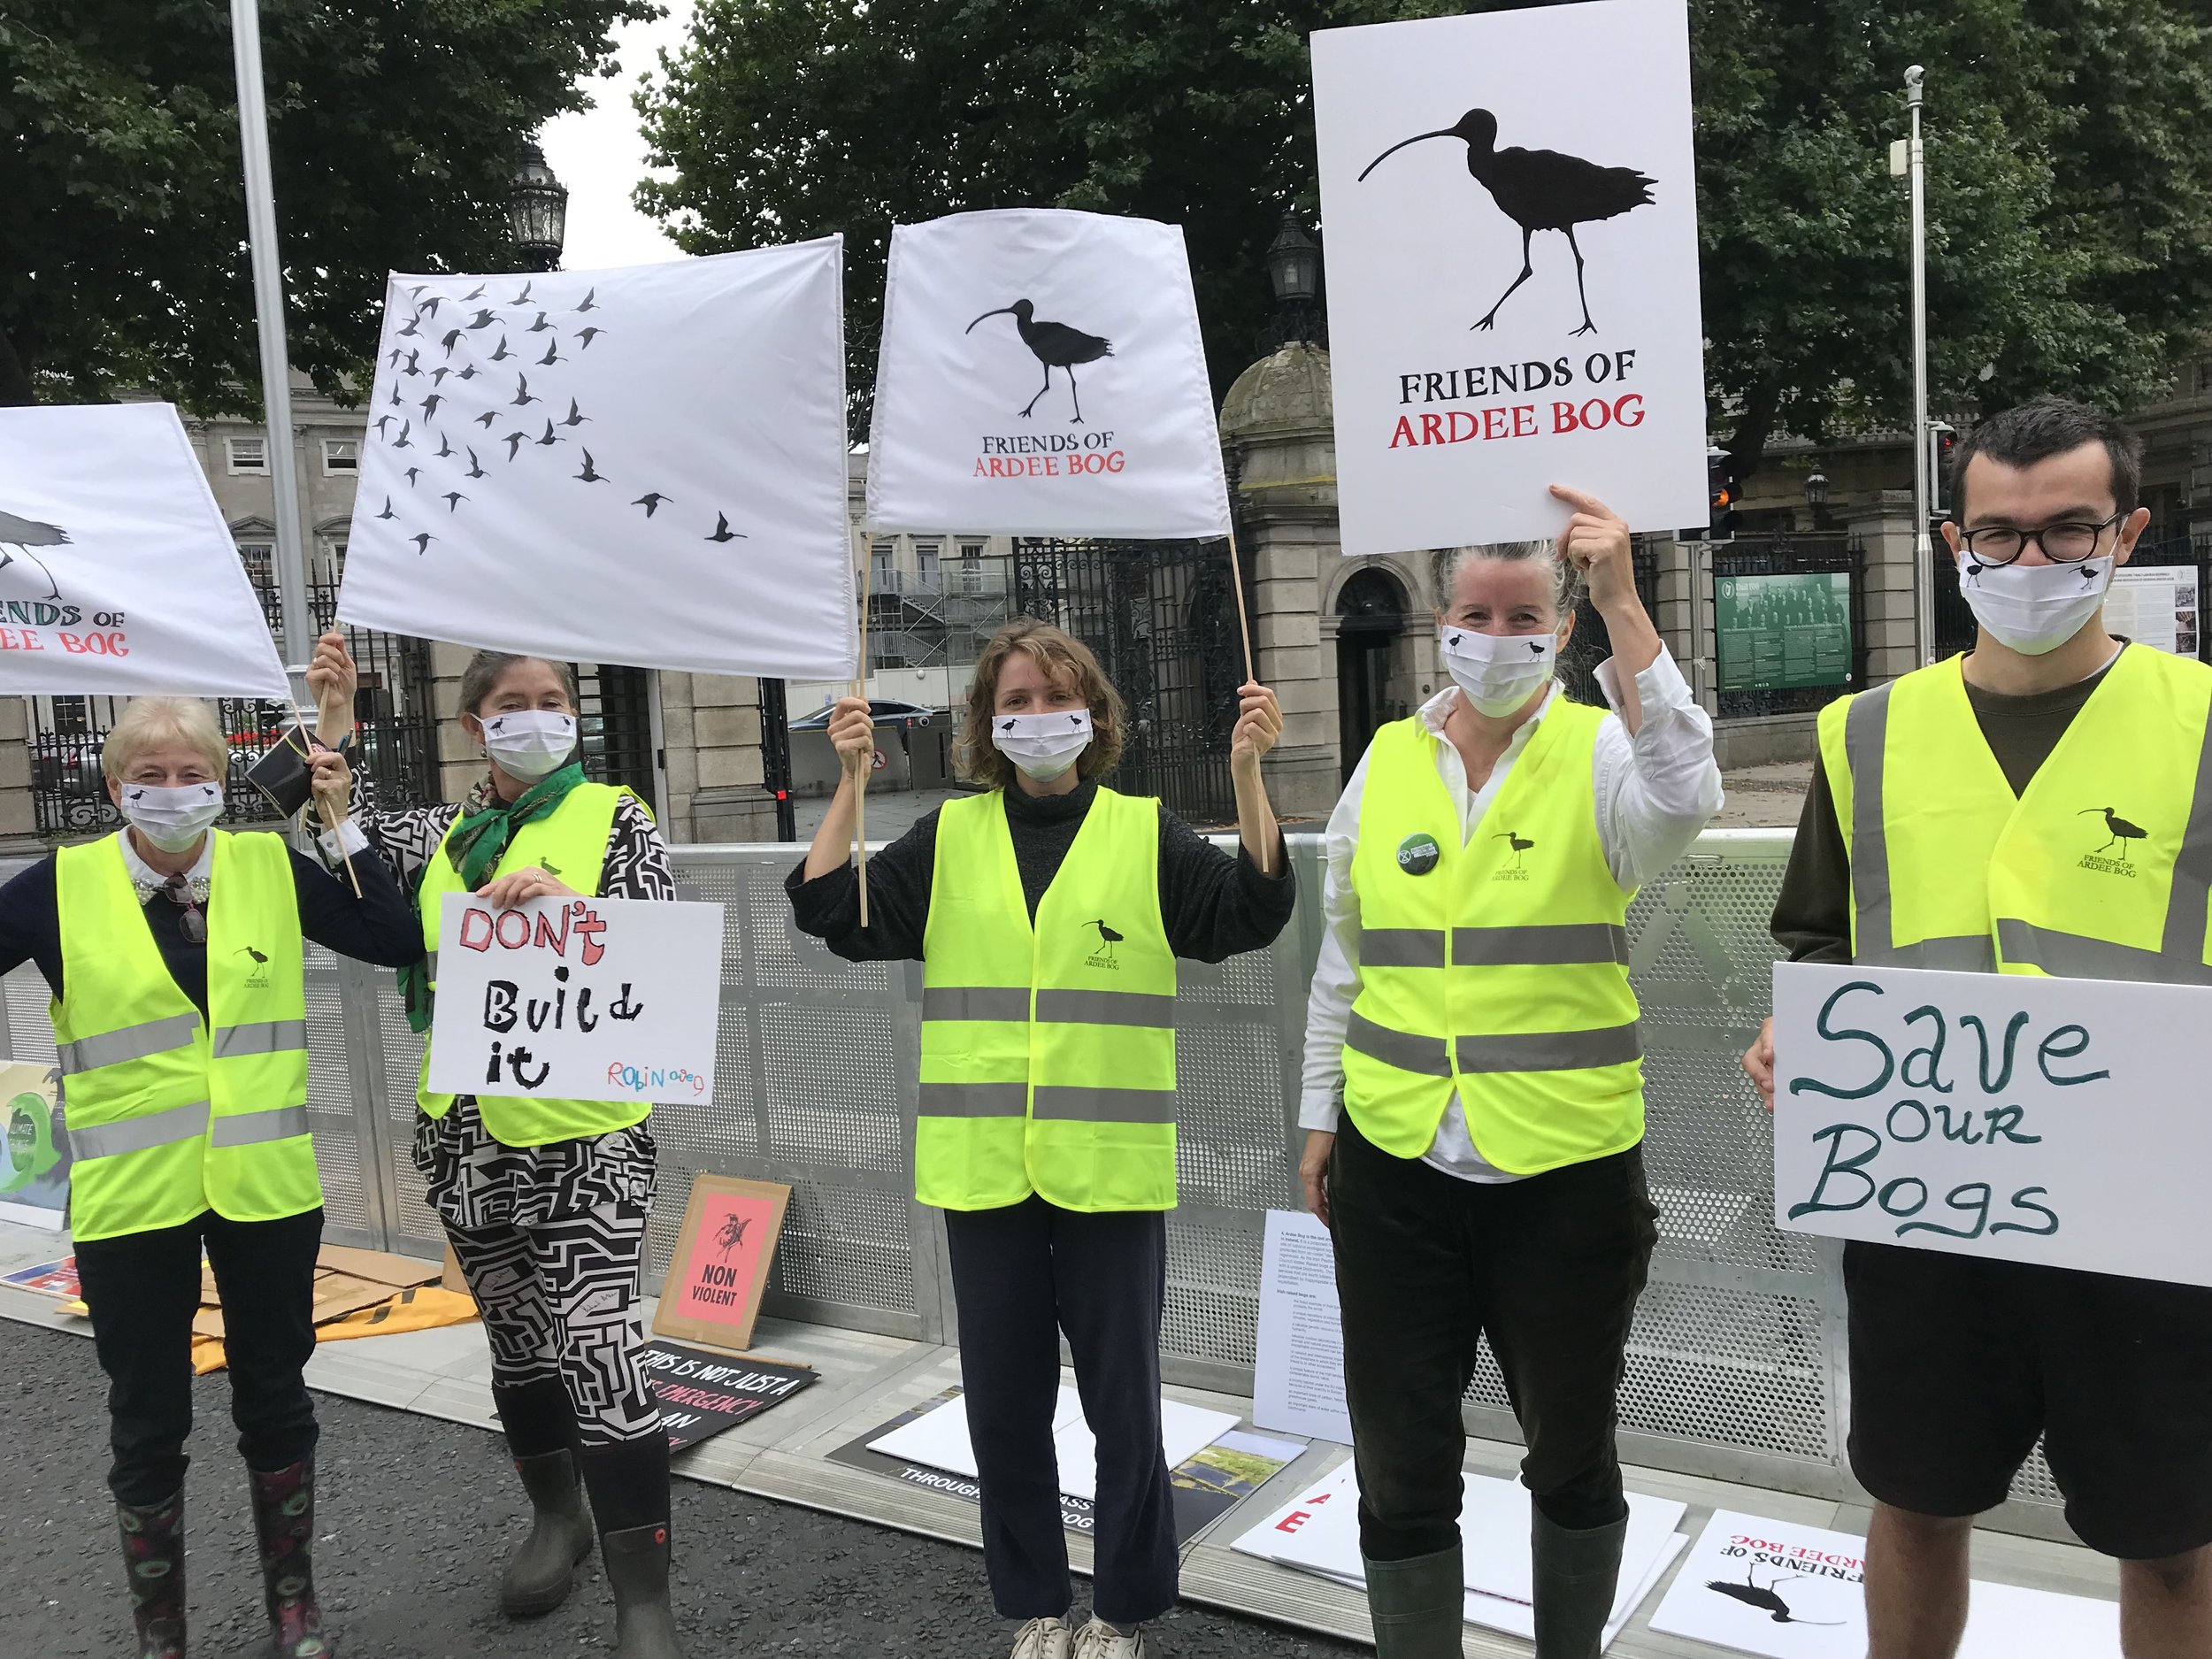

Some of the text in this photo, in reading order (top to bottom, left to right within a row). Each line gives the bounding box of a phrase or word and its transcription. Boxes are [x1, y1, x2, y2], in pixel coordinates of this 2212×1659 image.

[1399, 349, 1636, 404] FRIENDS OF
[1387, 393, 1646, 449] ARDEE BOG
[982, 431, 1115, 454] FRIENDS OF
[972, 450, 1125, 478] ARDEE BOG
[92, 611, 125, 627] OF
[56, 632, 130, 657] BOG
[2077, 860, 2137, 879] ARDEE BOG
[2084, 854, 2121, 867] FRIENDS
[1788, 980, 2111, 1101] Save
[486, 1041, 550, 1090] it
[1787, 1123, 2060, 1240] Bogs
[701, 1263, 738, 1287] NON
[692, 1285, 738, 1307] VIOLENT
[670, 1359, 702, 1376] IS
[691, 1364, 741, 1384] NOT
[724, 1372, 788, 1394] JUST
[769, 1379, 801, 1396] A
[655, 1383, 764, 1416] EMERGENCY
[1719, 1545, 1747, 1558] OF
[1730, 1534, 1865, 1571] RDEE BOG
